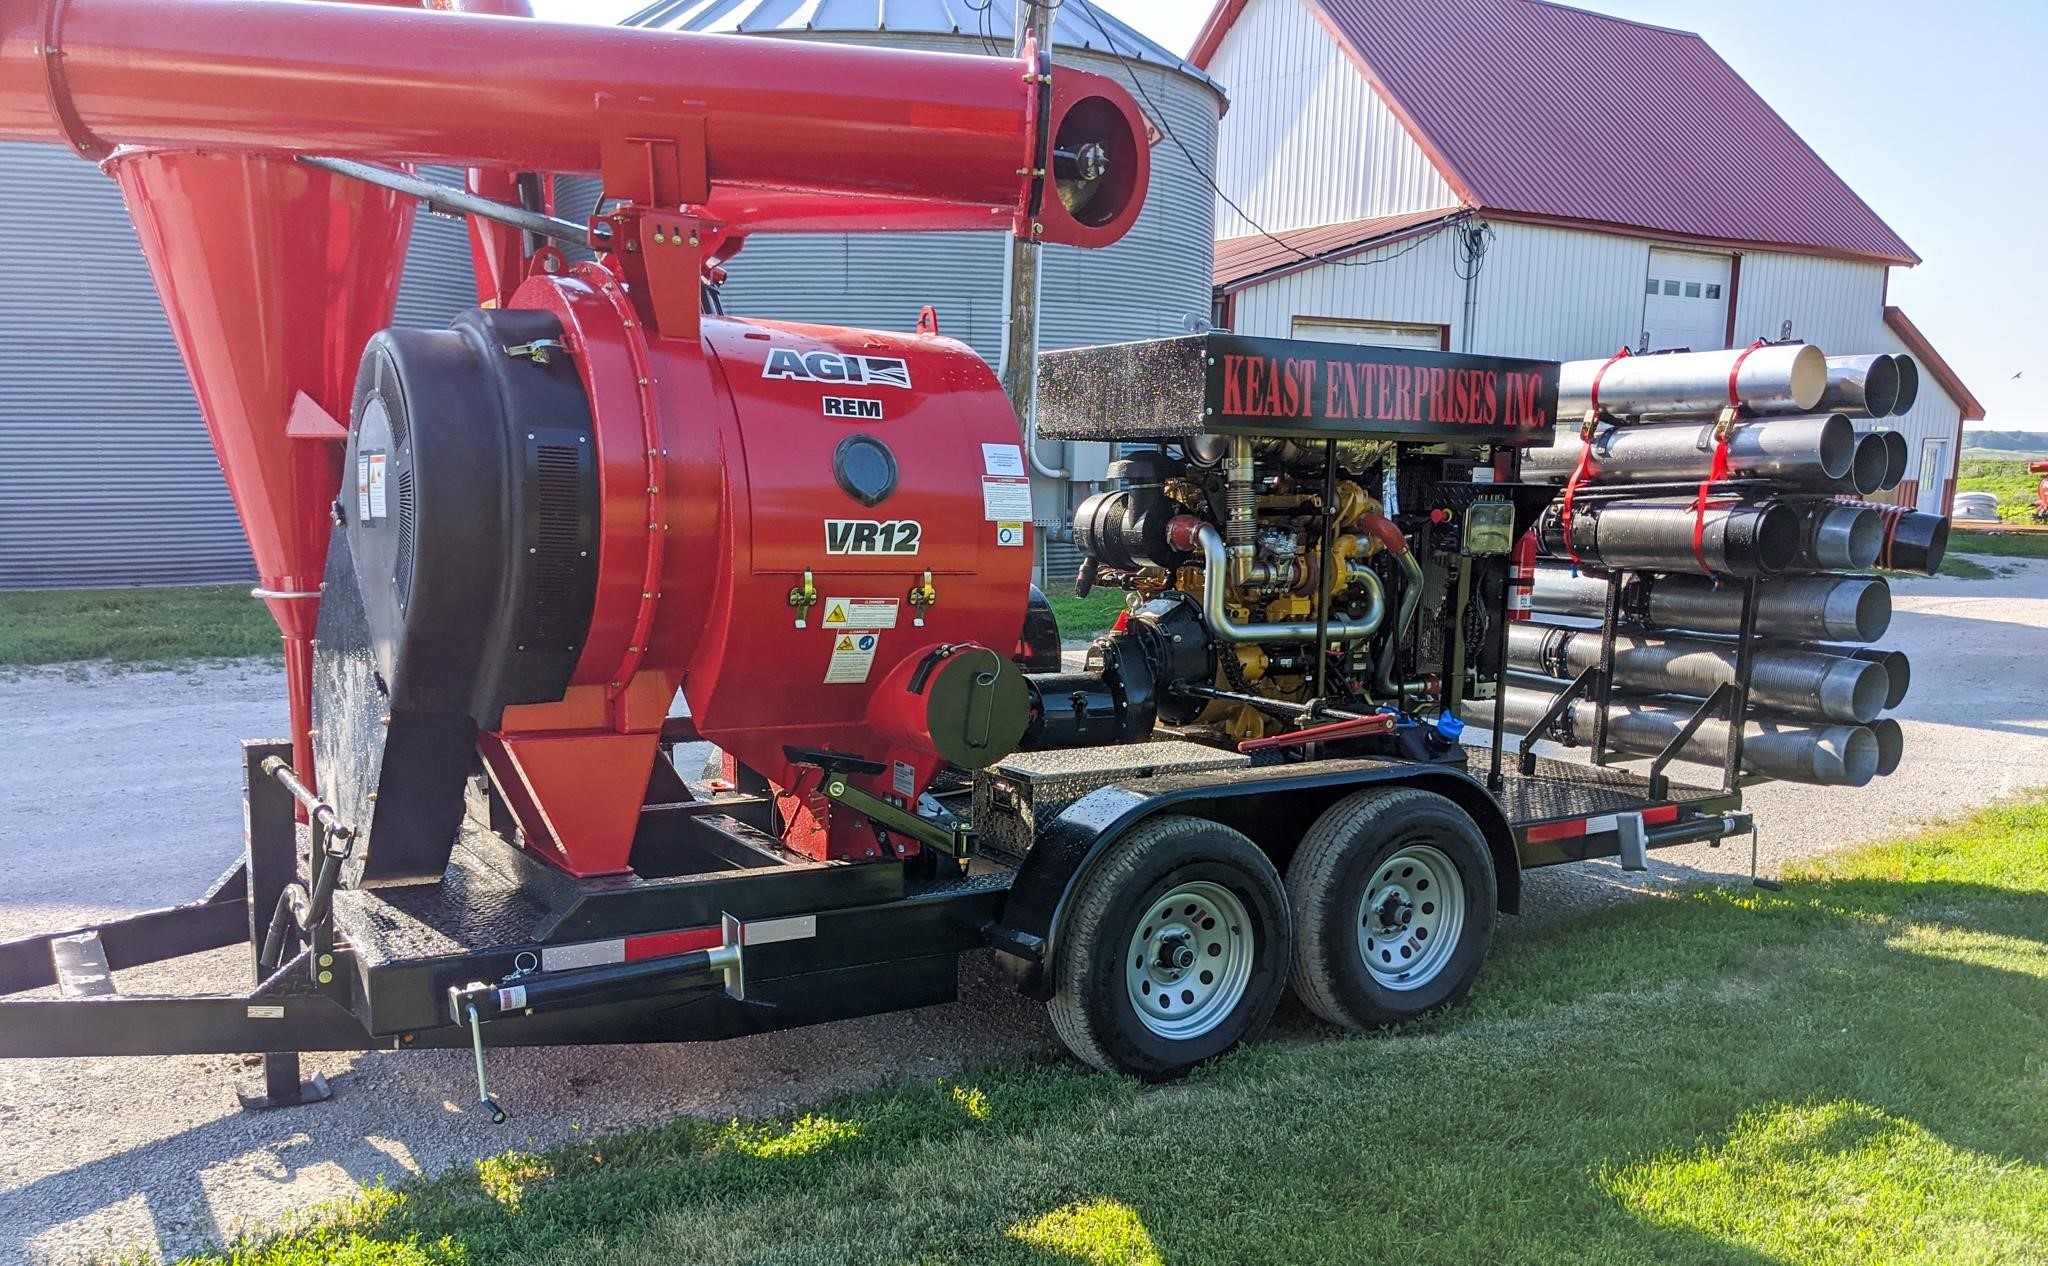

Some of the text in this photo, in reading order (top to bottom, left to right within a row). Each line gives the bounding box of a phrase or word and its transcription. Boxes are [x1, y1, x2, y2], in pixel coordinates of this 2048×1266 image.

[766, 349, 864, 382] AGI
[824, 397, 881, 417] REM
[1222, 355, 1546, 428] KEAST ENTERPRISES INC.
[827, 522, 919, 552] VR12
